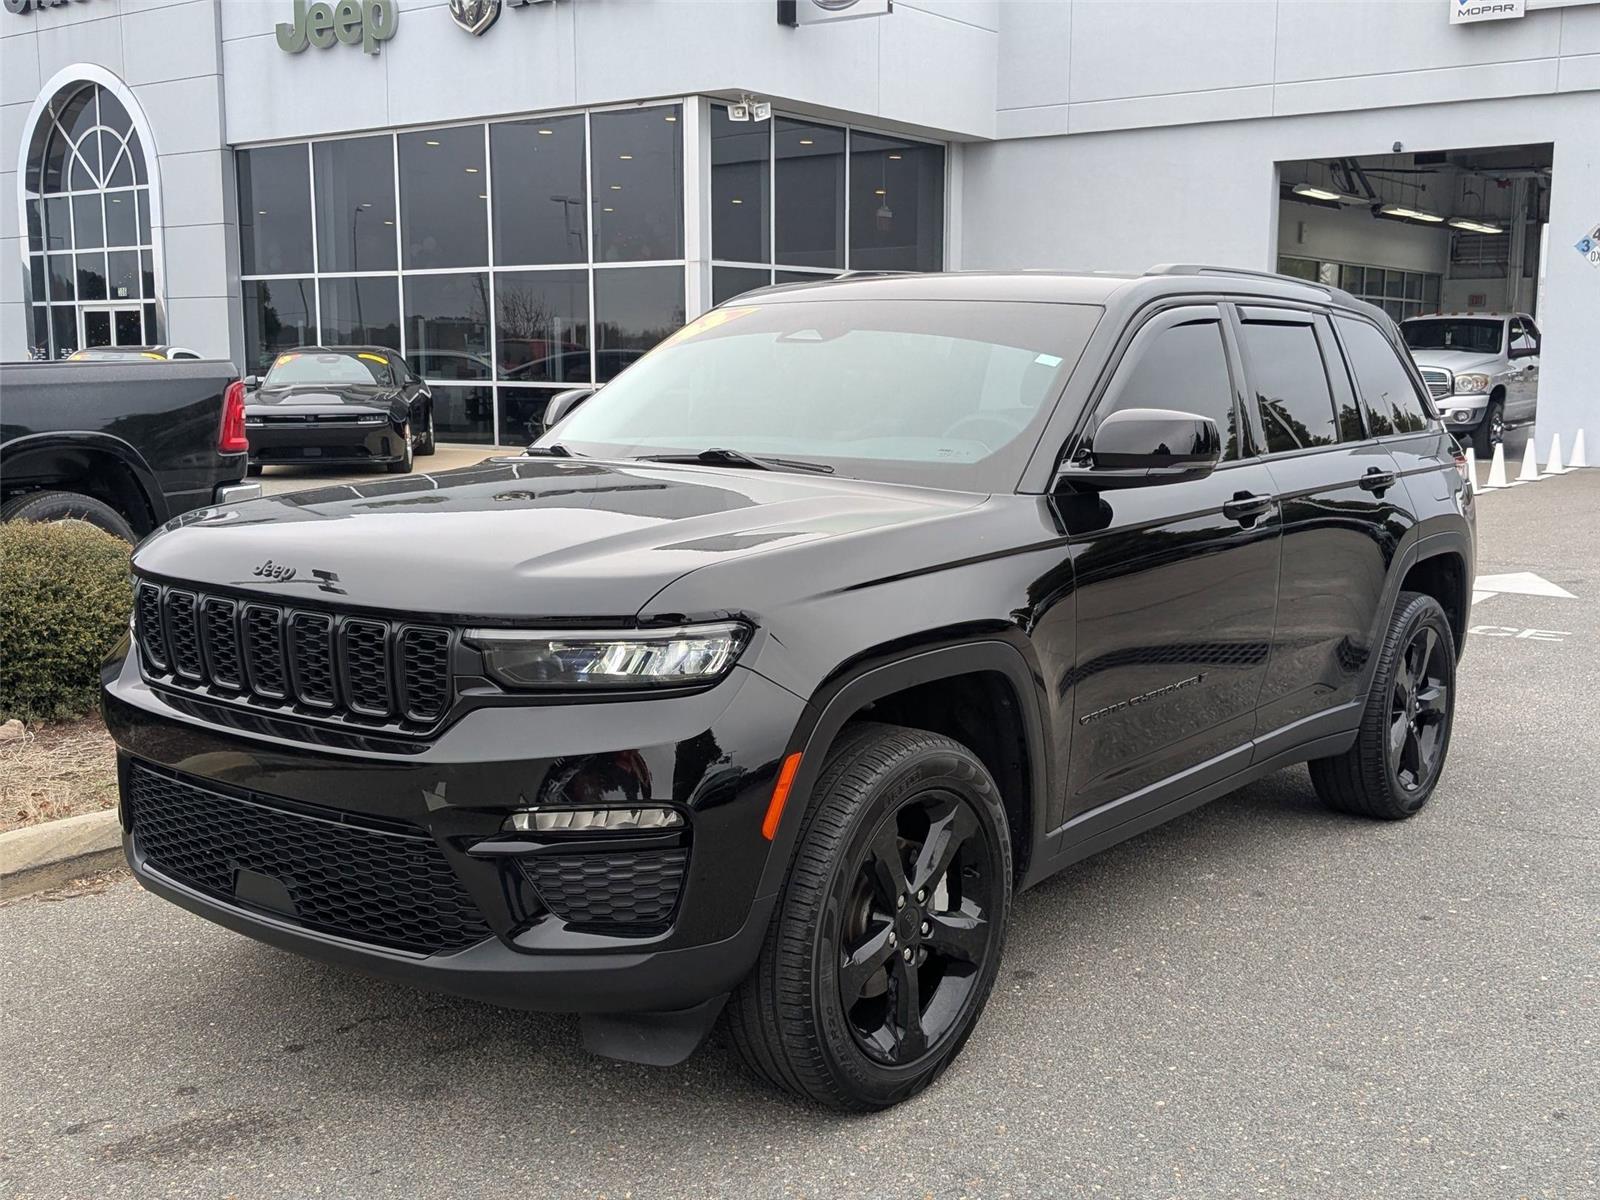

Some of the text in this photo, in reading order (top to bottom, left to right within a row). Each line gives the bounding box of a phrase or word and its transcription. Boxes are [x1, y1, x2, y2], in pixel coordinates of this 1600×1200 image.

[1457, 4, 1514, 17] MOPAR
[276, 0, 398, 55] Jeep
[1582, 239, 1591, 252] 3
[252, 559, 297, 583] Jeep
